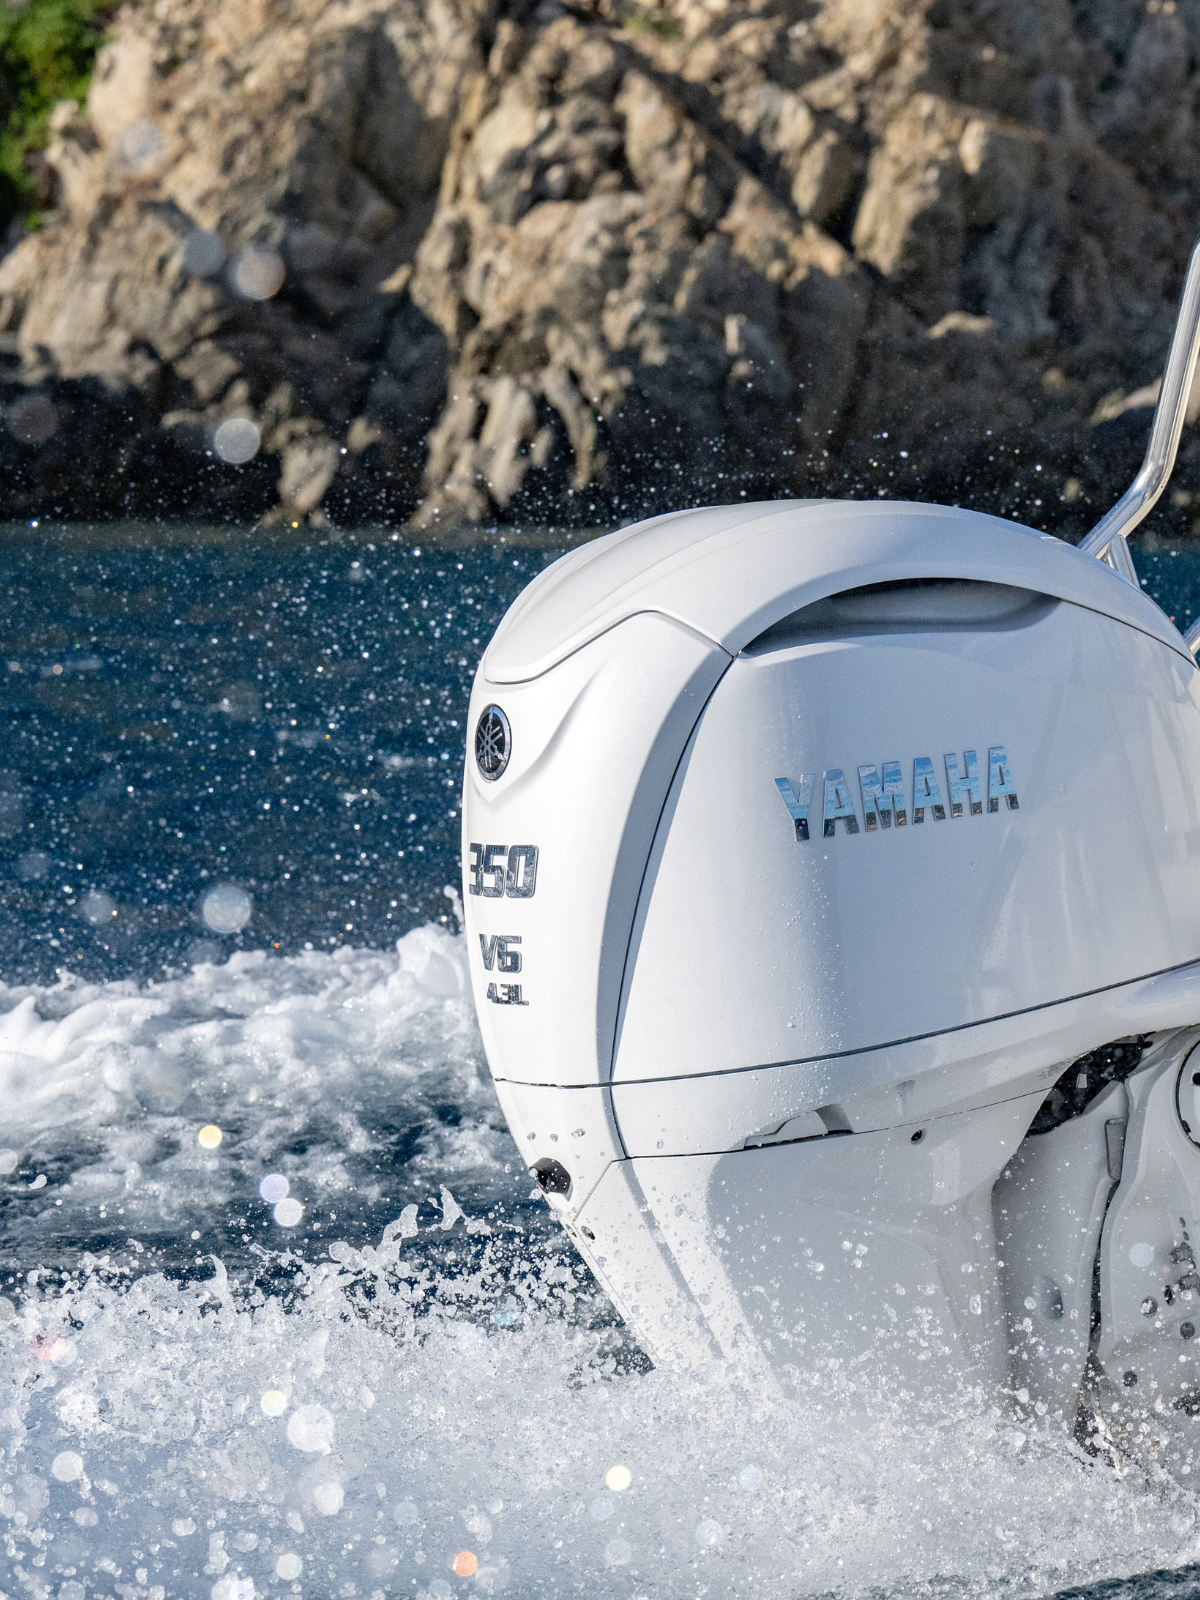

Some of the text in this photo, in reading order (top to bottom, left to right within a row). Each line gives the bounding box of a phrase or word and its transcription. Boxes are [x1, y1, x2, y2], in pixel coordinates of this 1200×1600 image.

[773, 746, 1020, 842] YAMAHA
[469, 842, 540, 899] 350
[479, 933, 523, 974] V6
